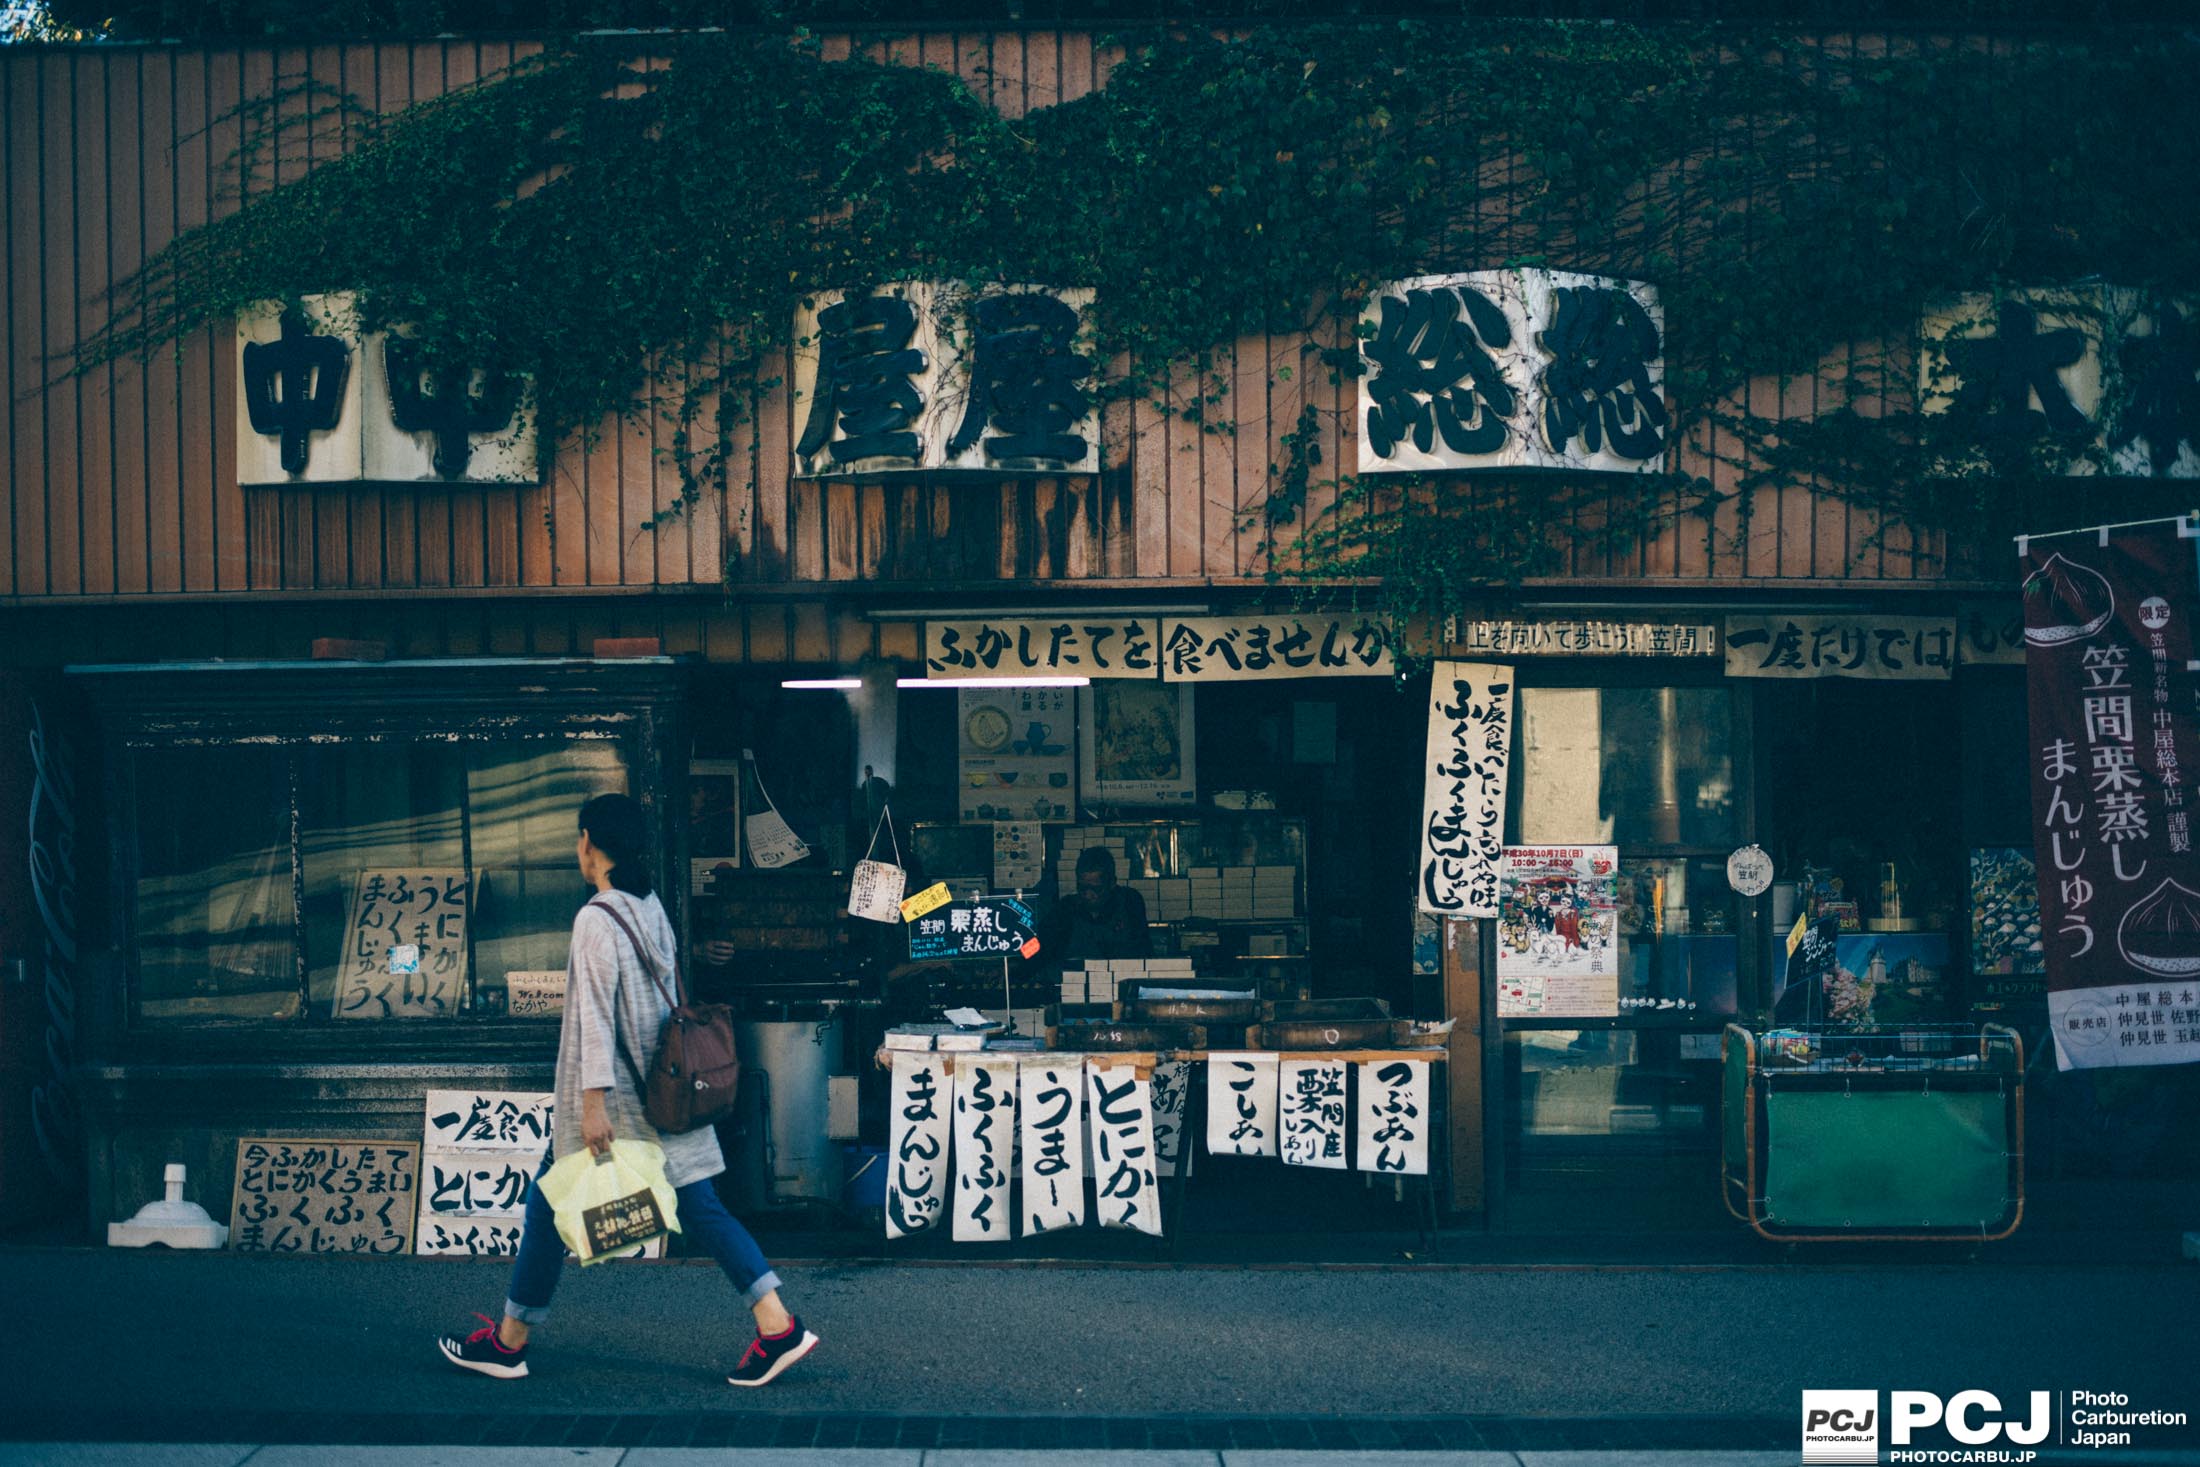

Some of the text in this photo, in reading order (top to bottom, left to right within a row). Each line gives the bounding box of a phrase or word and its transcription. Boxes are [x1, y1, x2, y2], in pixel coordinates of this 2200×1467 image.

[243, 300, 350, 475] 中
[797, 293, 1091, 462] 屋 屋
[1366, 285, 1668, 460] 総 総
[2139, 605, 2169, 620] 限定
[928, 621, 1153, 672] ふかしたてを
[1166, 623, 1392, 675] 食べませんか
[1727, 621, 1955, 671] 一度だけでは
[2082, 644, 2150, 882] 笠間栗蒸し
[2153, 707, 2183, 807] 中屋総本店
[1427, 679, 1482, 910] ふくふくまんじゅう
[2042, 738, 2096, 959] まんじゅう
[2167, 811, 2191, 853] 謹製
[1512, 859, 1537, 867] 10:00
[344, 873, 387, 1011] まんじゅう
[434, 876, 466, 1010] とにかく
[919, 919, 946, 935] 笠間
[950, 906, 1008, 934] 栗蒸し
[961, 930, 1025, 952] まんじゅう
[512, 999, 548, 1013] なかや
[2116, 988, 2200, 1008] 中屋総本
[2118, 1010, 2166, 1028] 仲見世
[2068, 1017, 2108, 1031] 販売店
[2120, 1029, 2168, 1047] 仲見世
[1283, 1094, 1304, 1165] こしあん
[1296, 1068, 1325, 1161] 栗入り
[1321, 1067, 1344, 1160] 笠間産
[1371, 1062, 1419, 1172] つぶあん
[245, 1144, 410, 1170] 今ふかしたて
[888, 1067, 941, 1236] まんじゅう
[957, 1067, 1013, 1233] ふくふく
[1092, 1074, 1155, 1230] とにかく
[241, 1169, 412, 1194] とにかくうまい
[239, 1194, 396, 1227] ふくふく
[235, 1224, 406, 1255] まんじゅう
